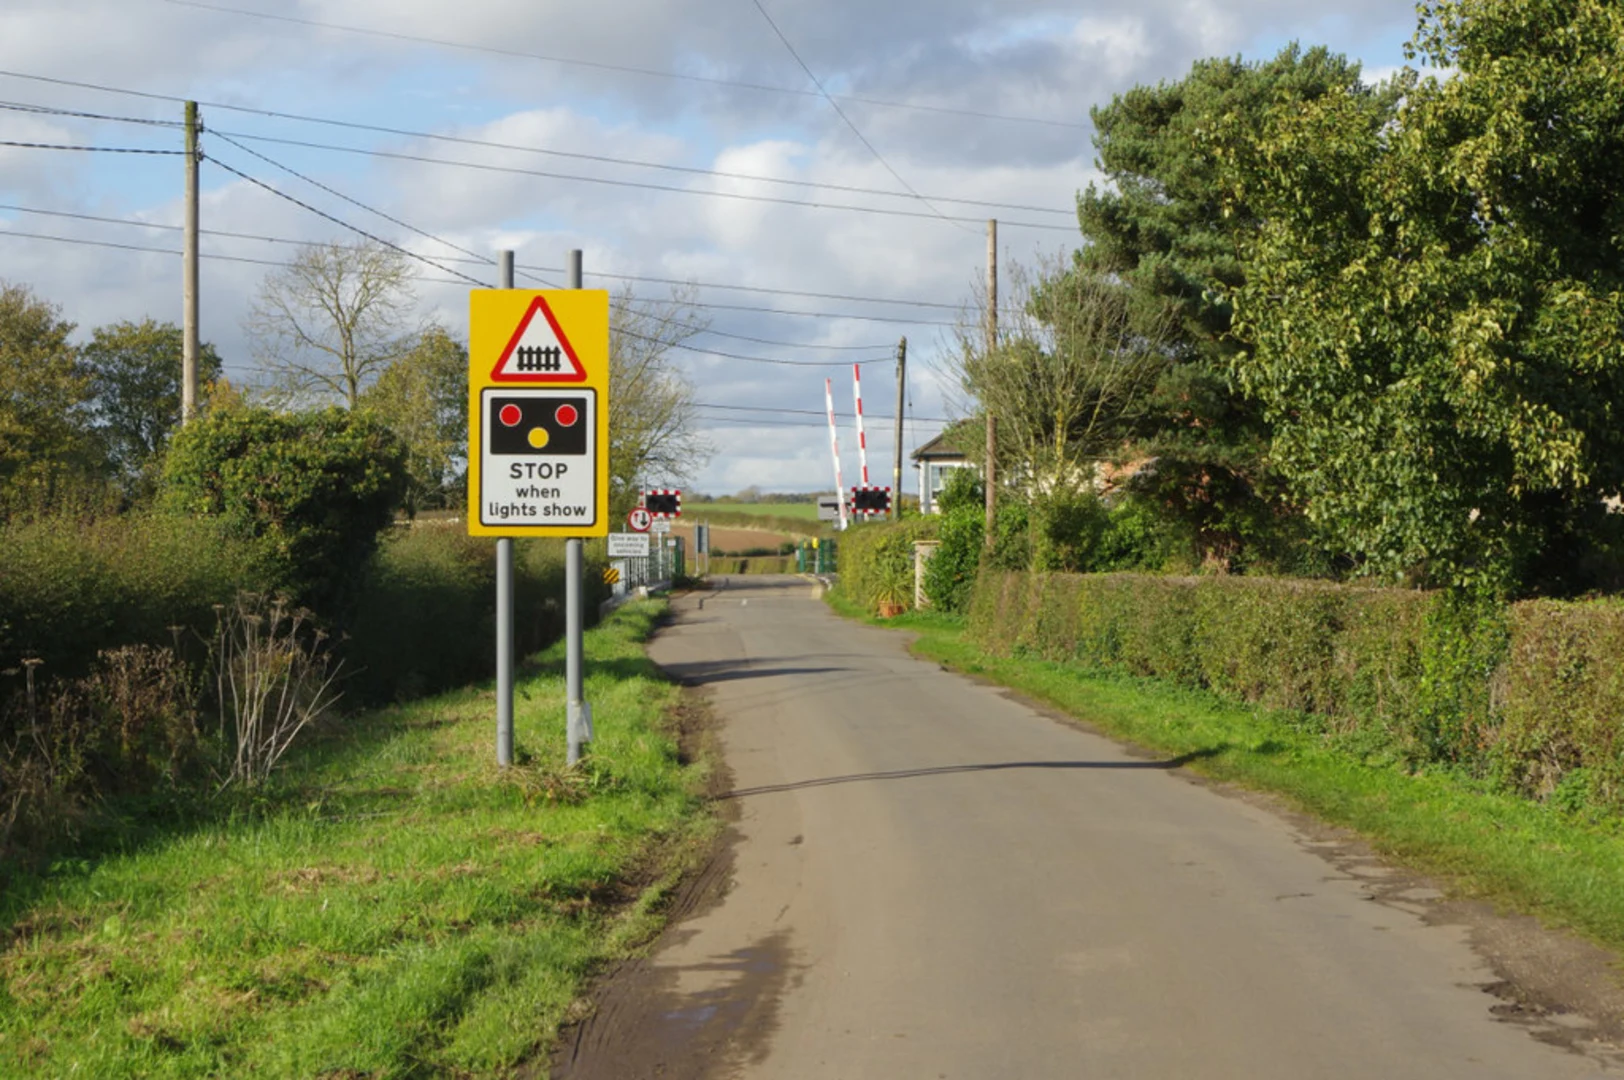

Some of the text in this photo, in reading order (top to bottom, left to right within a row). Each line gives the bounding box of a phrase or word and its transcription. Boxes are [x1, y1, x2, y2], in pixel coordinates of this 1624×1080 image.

[510, 462, 568, 479] STOP
[516, 484, 560, 498] when
[489, 502, 586, 519] lights show
